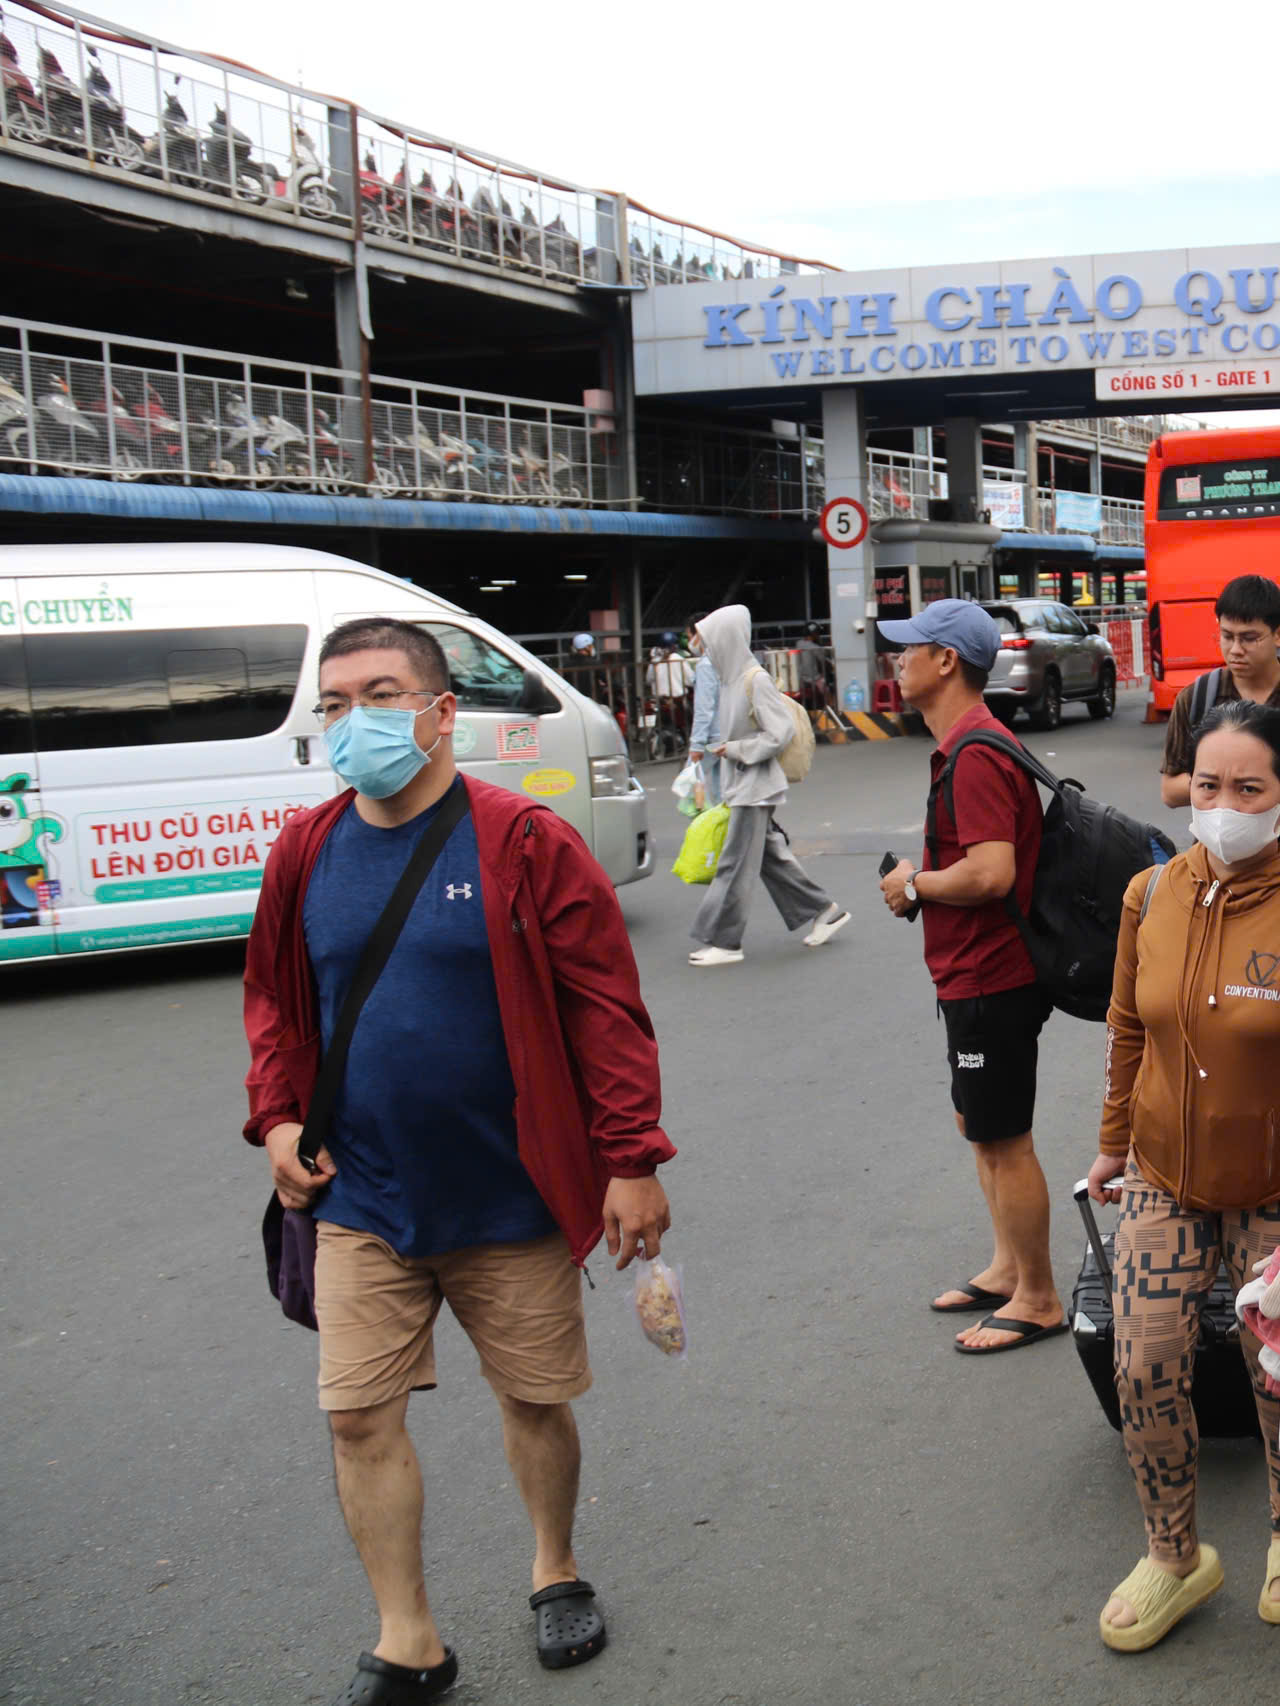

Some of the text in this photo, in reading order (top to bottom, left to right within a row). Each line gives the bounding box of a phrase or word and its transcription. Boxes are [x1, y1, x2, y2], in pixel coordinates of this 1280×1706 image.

[703, 285, 898, 347] KÍNH
[925, 266, 1143, 331] CHÀO
[771, 335, 997, 378] WELCOME
[1010, 334, 1069, 364] TO
[1079, 326, 1209, 360] WEST
[1162, 368, 1184, 388] SỐ
[1190, 374, 1198, 387] 1
[1217, 371, 1257, 386] GATE
[1263, 370, 1271, 384] 1
[837, 511, 850, 534] 5
[24, 582, 134, 625] CHUYỂN
[90, 820, 151, 846] THU
[160, 812, 199, 840] CŨ
[207, 806, 255, 836] GIÁ
[91, 838, 260, 879] LÊN ĐỜI GIÁ
